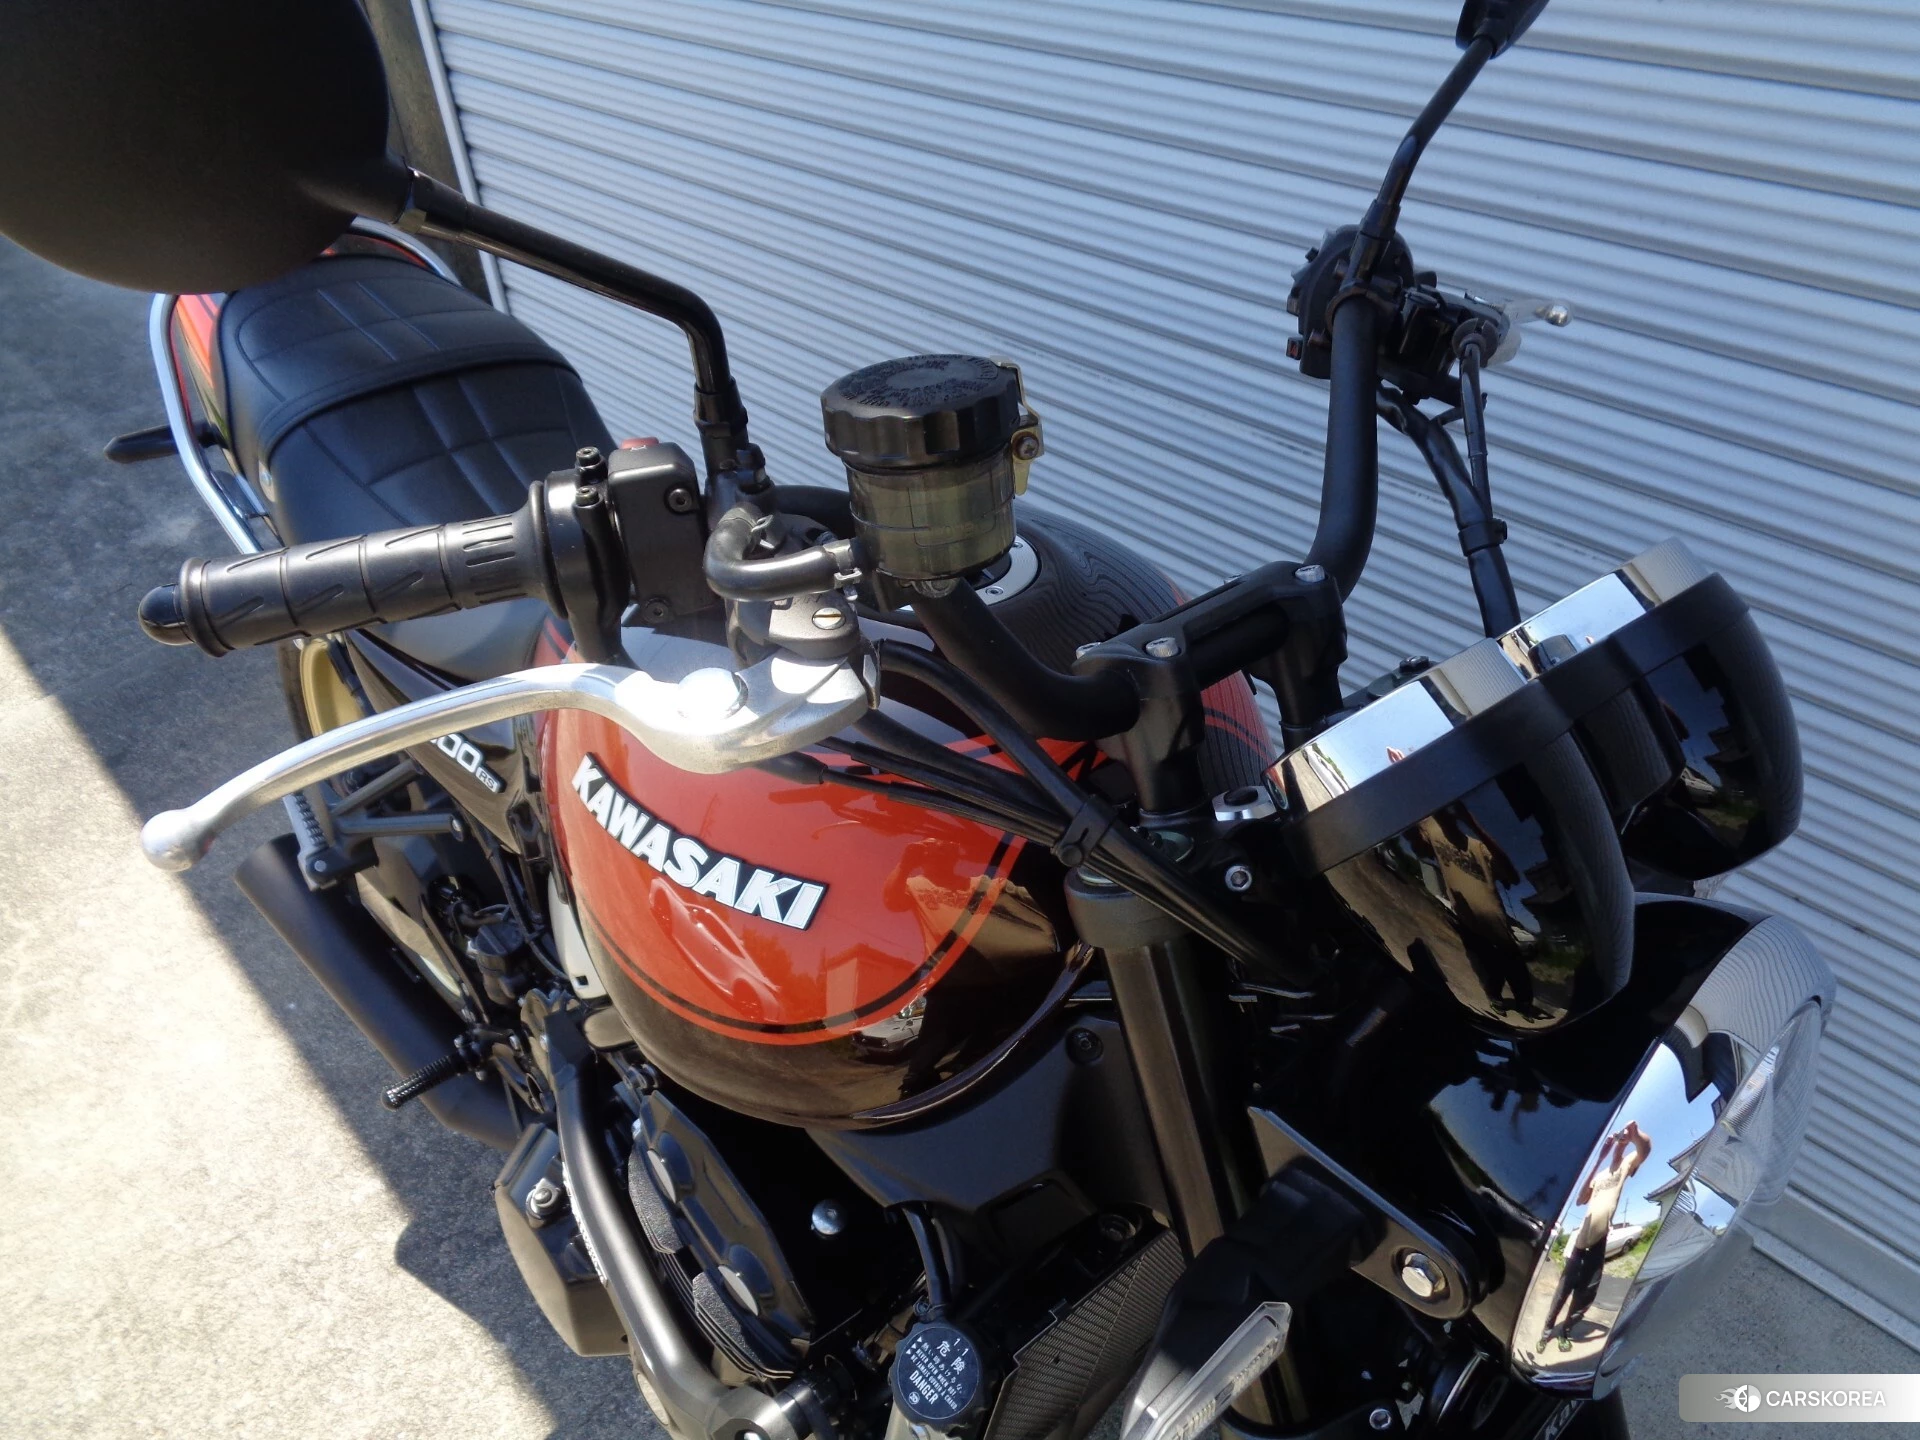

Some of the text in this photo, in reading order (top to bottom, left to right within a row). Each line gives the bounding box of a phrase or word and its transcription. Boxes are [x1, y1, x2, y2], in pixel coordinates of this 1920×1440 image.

[430, 733, 496, 790] 00 RS
[571, 753, 823, 929] KAWASAKI
[908, 1369, 939, 1405] DANGER
[915, 1348, 929, 1363] NEVER
[927, 1361, 939, 1375] OPEN
[937, 1373, 950, 1387] WHEN
